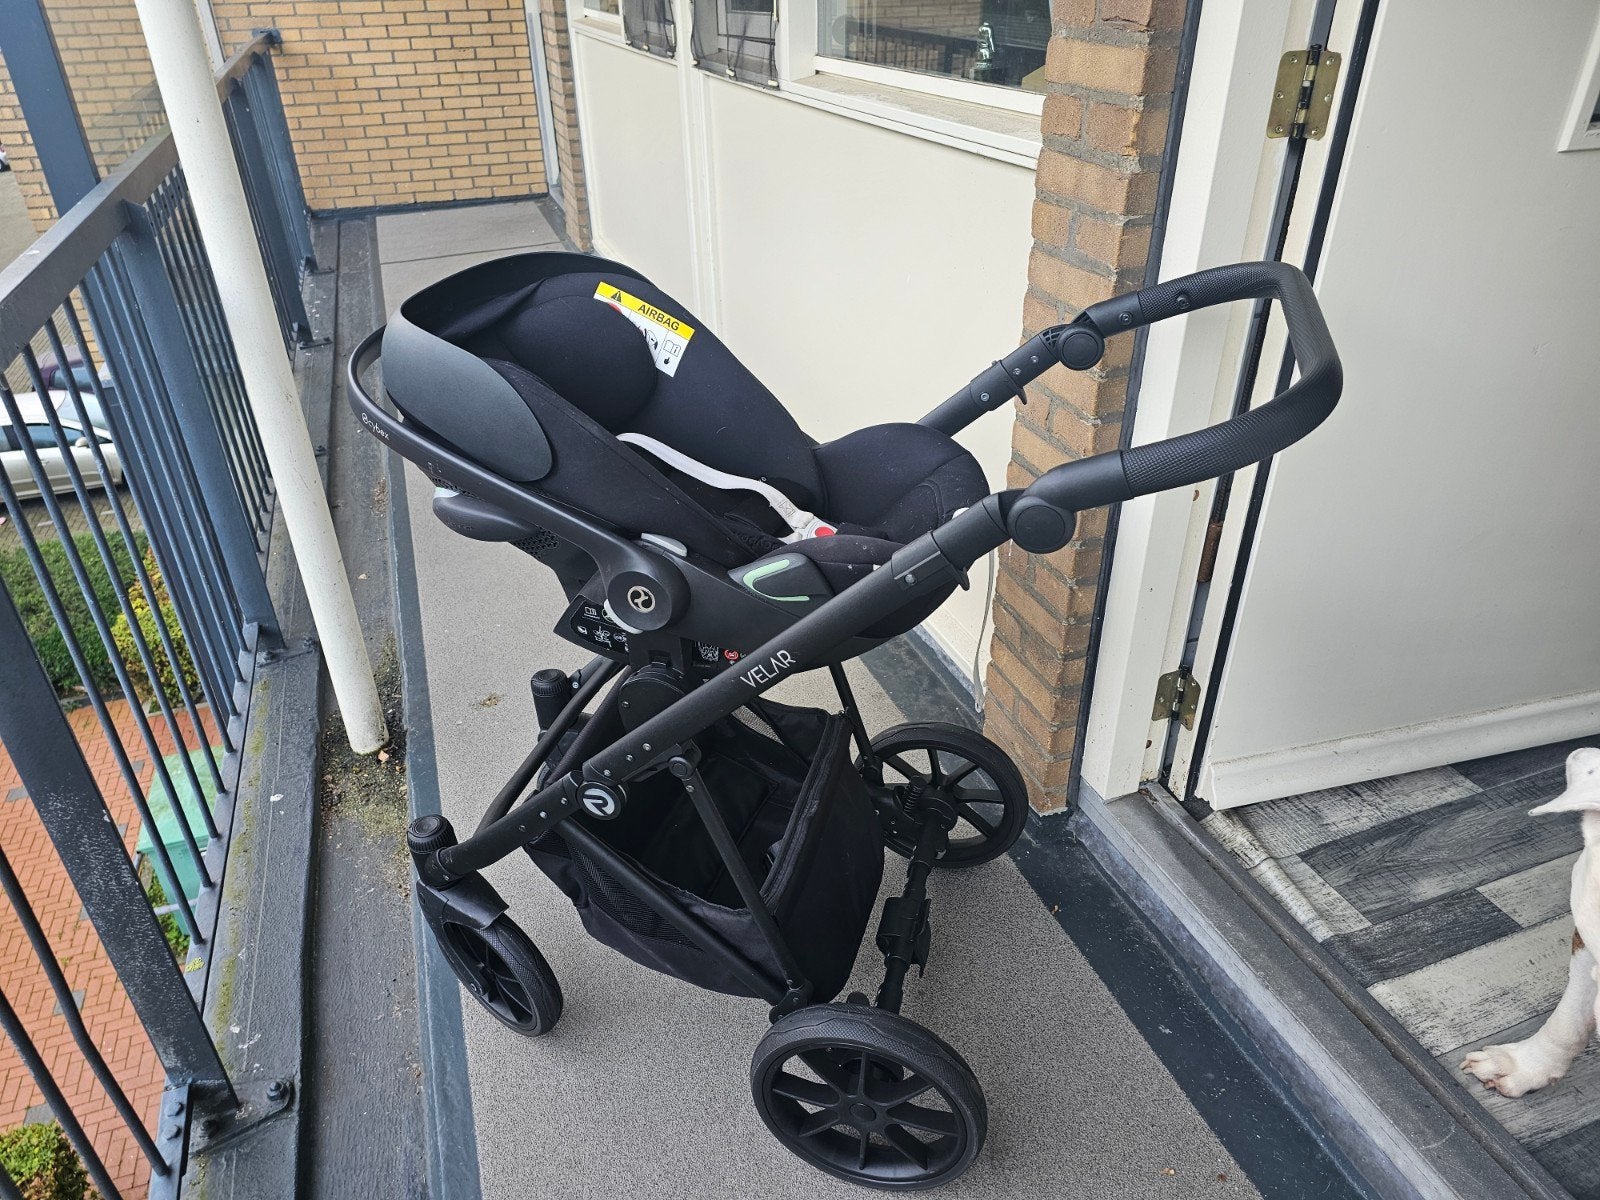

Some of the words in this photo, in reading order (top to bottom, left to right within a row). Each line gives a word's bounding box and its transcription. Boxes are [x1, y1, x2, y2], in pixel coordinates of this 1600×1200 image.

[638, 304, 680, 331] AIRBAG
[368, 420, 390, 440] cybex
[739, 650, 796, 688] VELAR
